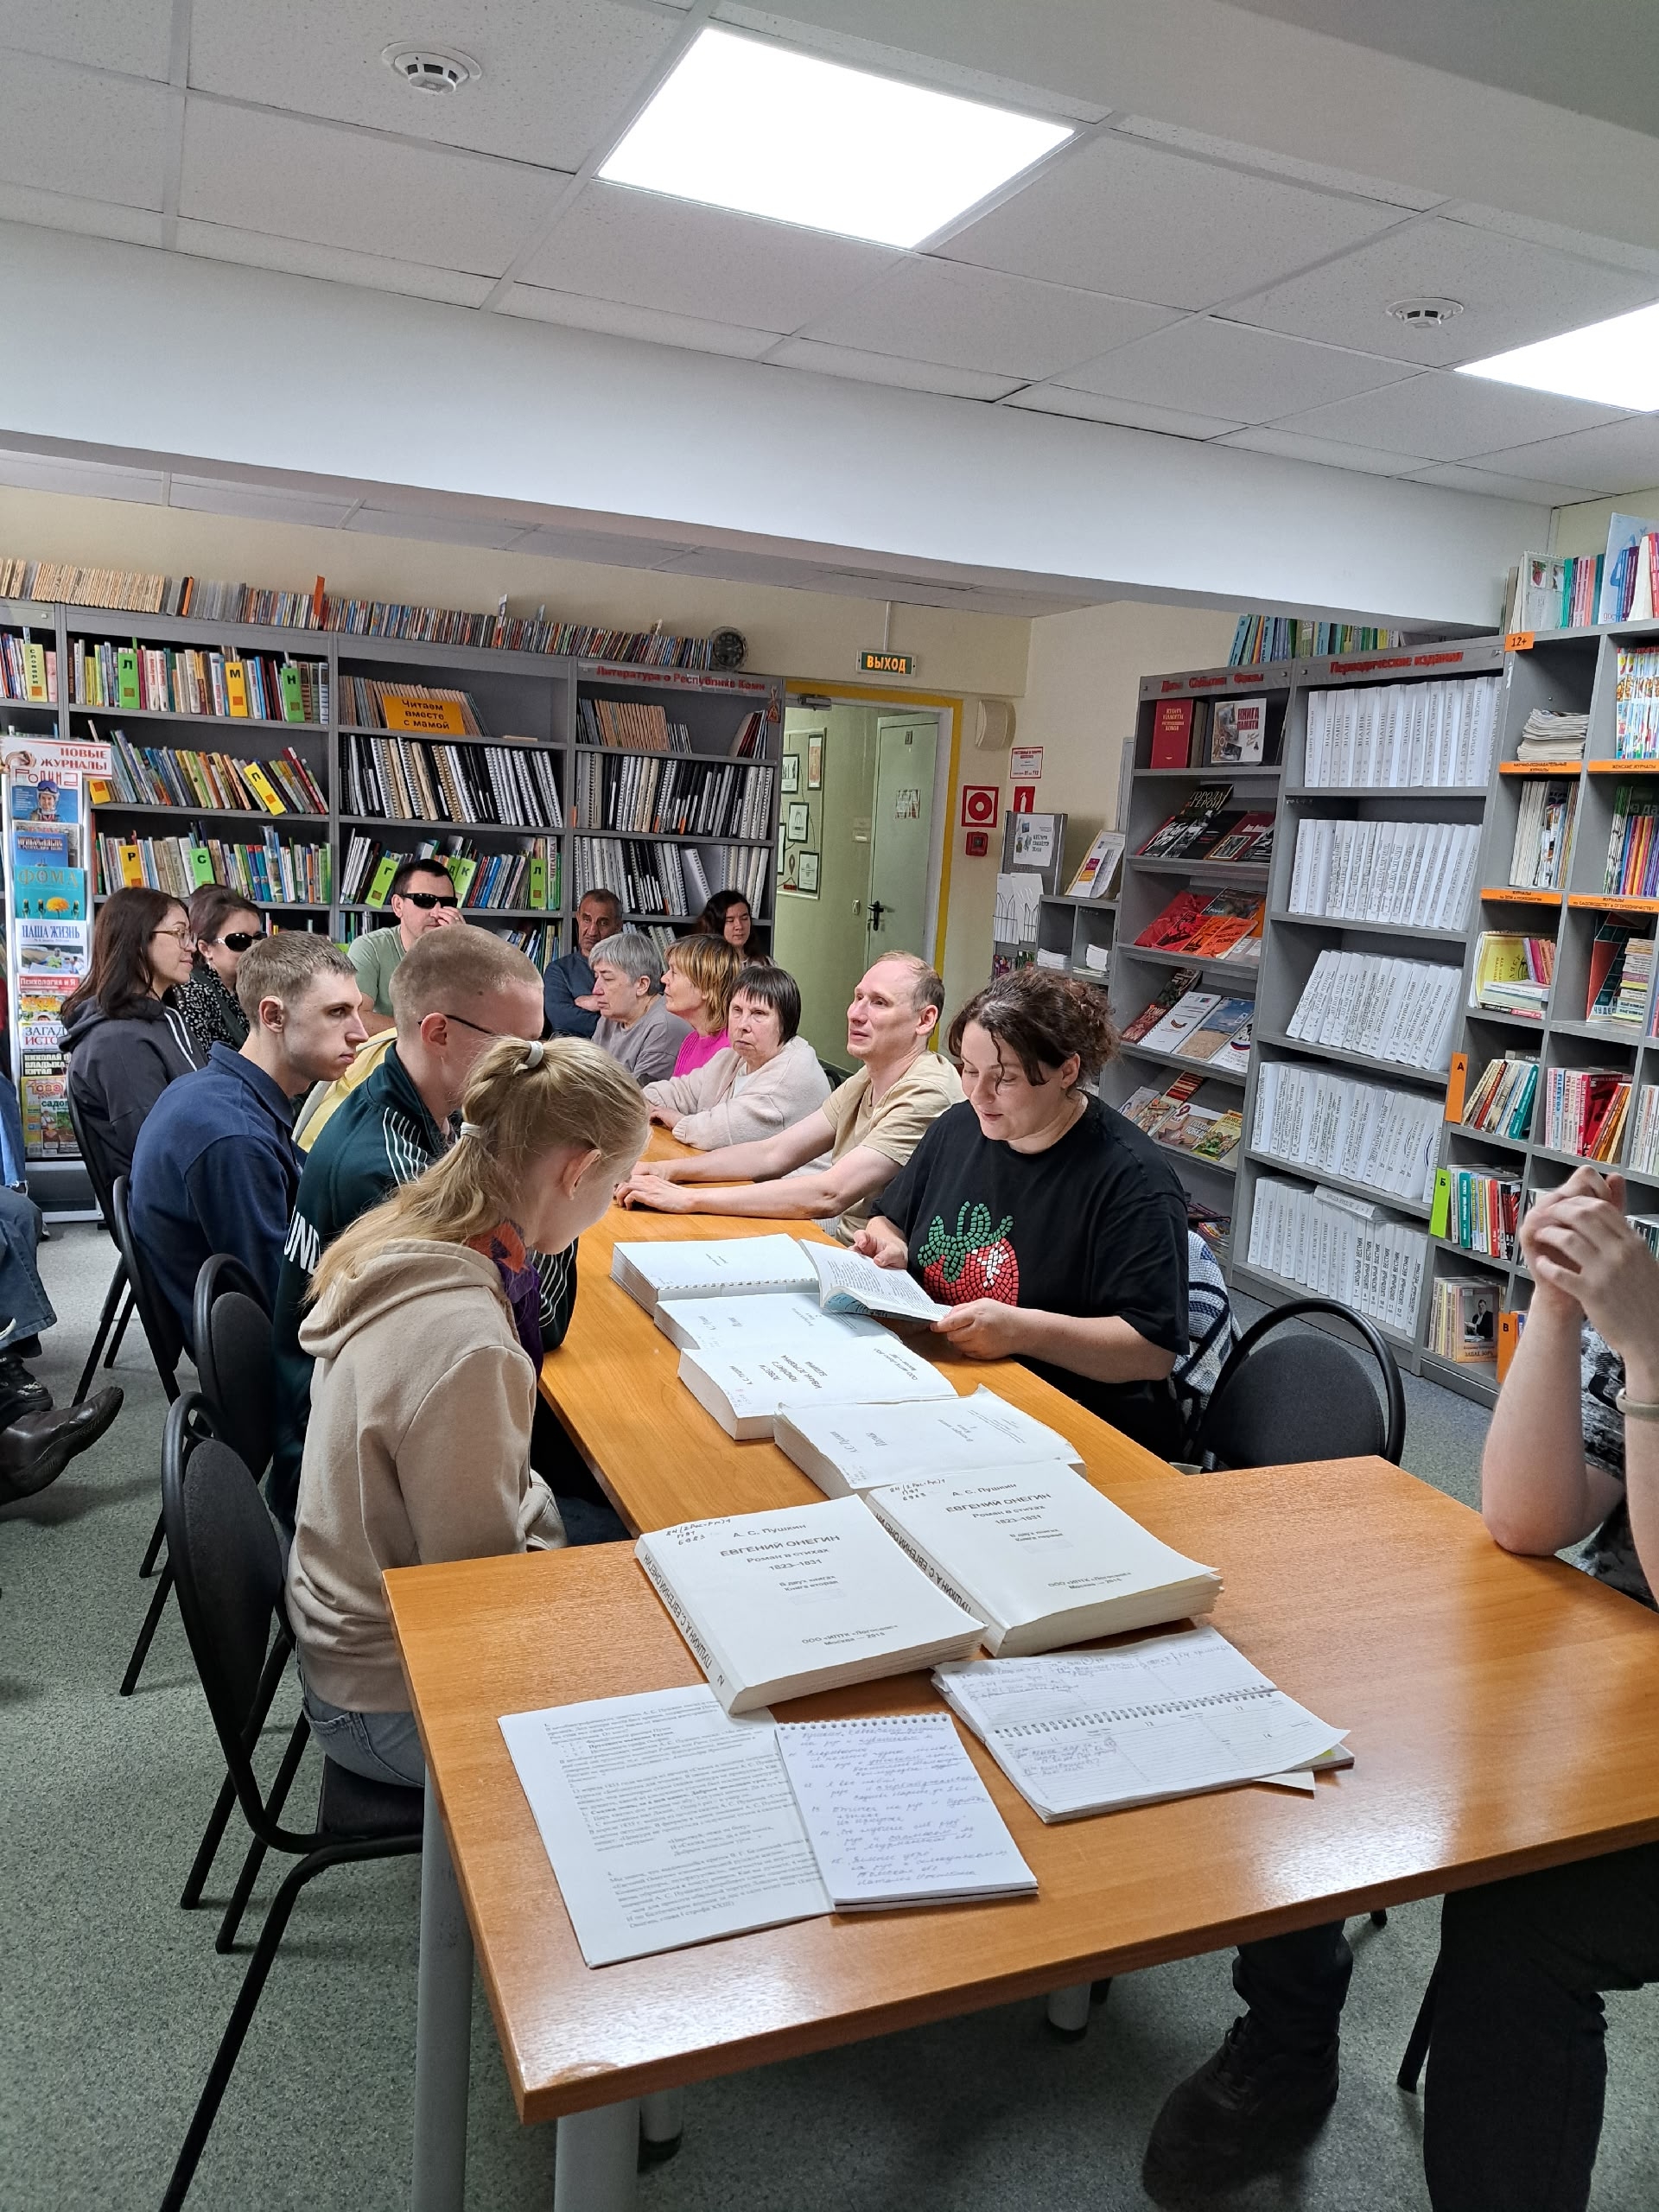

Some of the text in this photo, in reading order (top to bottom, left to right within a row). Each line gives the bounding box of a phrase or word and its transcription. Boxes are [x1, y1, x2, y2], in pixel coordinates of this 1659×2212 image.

[1511, 637, 1527, 648] 12+
[123, 659, 133, 670] Л
[867, 655, 906, 674] ВЫХОД
[229, 669, 241, 678] М
[596, 665, 662, 682] Литература
[287, 675, 296, 685] Н
[402, 699, 443, 711] Читаем
[404, 709, 444, 721] вместе
[413, 720, 449, 729] мамой
[60, 747, 107, 759] НОВЫЕ
[41, 758, 107, 771] ЖУРНАЛЫ
[127, 852, 136, 861] Р
[197, 855, 207, 864] С
[461, 867, 470, 876] К
[533, 867, 542, 875] Л
[18, 868, 79, 887] ФОМА
[22, 925, 80, 939] НАША ЖИЗНЬ
[20, 977, 63, 986] Психология
[25, 1027, 67, 1037] ЗАГАД
[25, 1036, 59, 1046] ИСТО
[1457, 1061, 1465, 1071] А
[1440, 1177, 1446, 1186] Б
[1397, 1277, 1406, 1305] ШКОЛЬНЫЙ
[1503, 1322, 1510, 1332] В
[977, 1483, 1017, 1494] Пушкин
[945, 1493, 1052, 1513] ЕВГЕНИЙ ОНЕГИН
[972, 1510, 1004, 1519] Роман
[1013, 1504, 1046, 1514] стихах
[761, 1523, 806, 1534] Пушкин
[1038, 1532, 1064, 1541] первая
[720, 1535, 841, 1557] ЕВГЕНИЙ ОНЕГИН
[746, 1554, 782, 1564] Роман
[792, 1548, 830, 1557] стихах
[899, 1535, 928, 1572] ЕВГЕНИЙ
[643, 1553, 663, 1585] ОНЕГИН
[808, 1575, 836, 1584] книгах
[809, 1580, 839, 1589] вторая
[661, 1578, 683, 1618] ЕВГЕНИЙ
[941, 1580, 971, 1614] ПУШКИН
[823, 1637, 855, 1646] Москва
[690, 1632, 713, 1670] ПУШКИН
[716, 1674, 725, 1687] 2
